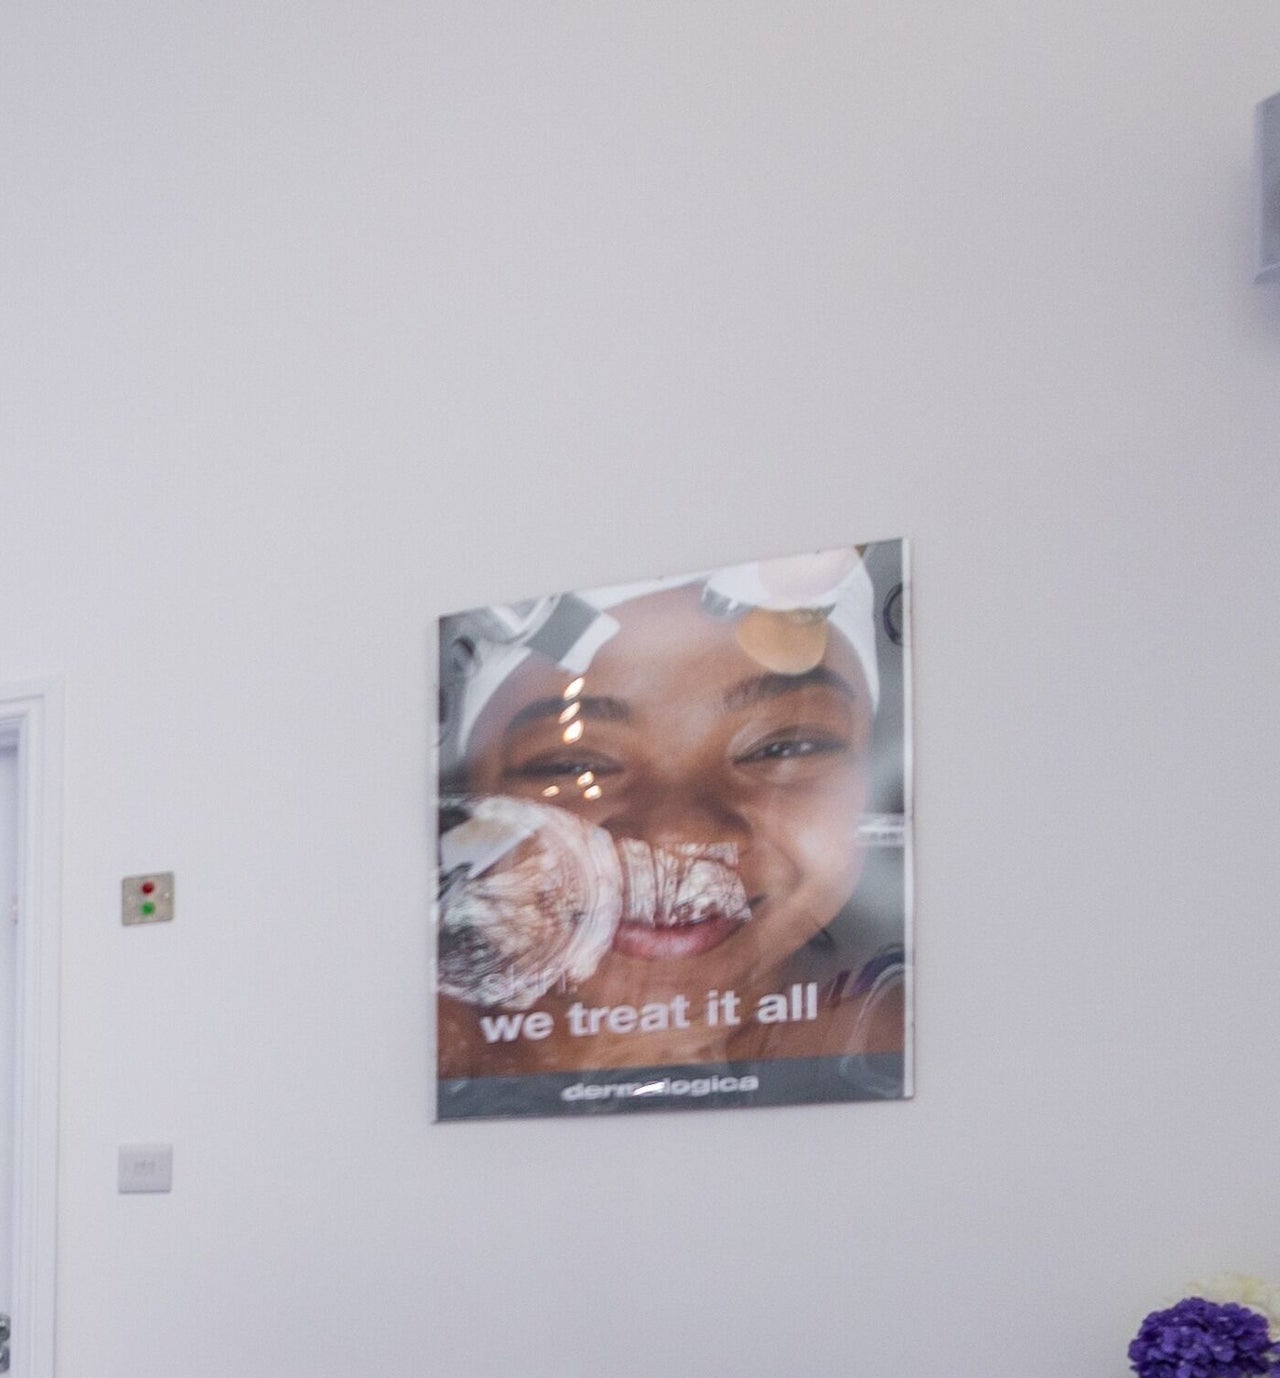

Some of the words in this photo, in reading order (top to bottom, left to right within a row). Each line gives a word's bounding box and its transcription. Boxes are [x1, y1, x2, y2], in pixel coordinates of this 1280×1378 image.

[480, 1011, 554, 1043] we
[566, 994, 690, 1037] treat
[706, 989, 740, 1026] it
[757, 983, 818, 1024] all
[561, 1075, 759, 1101] dermlogica
